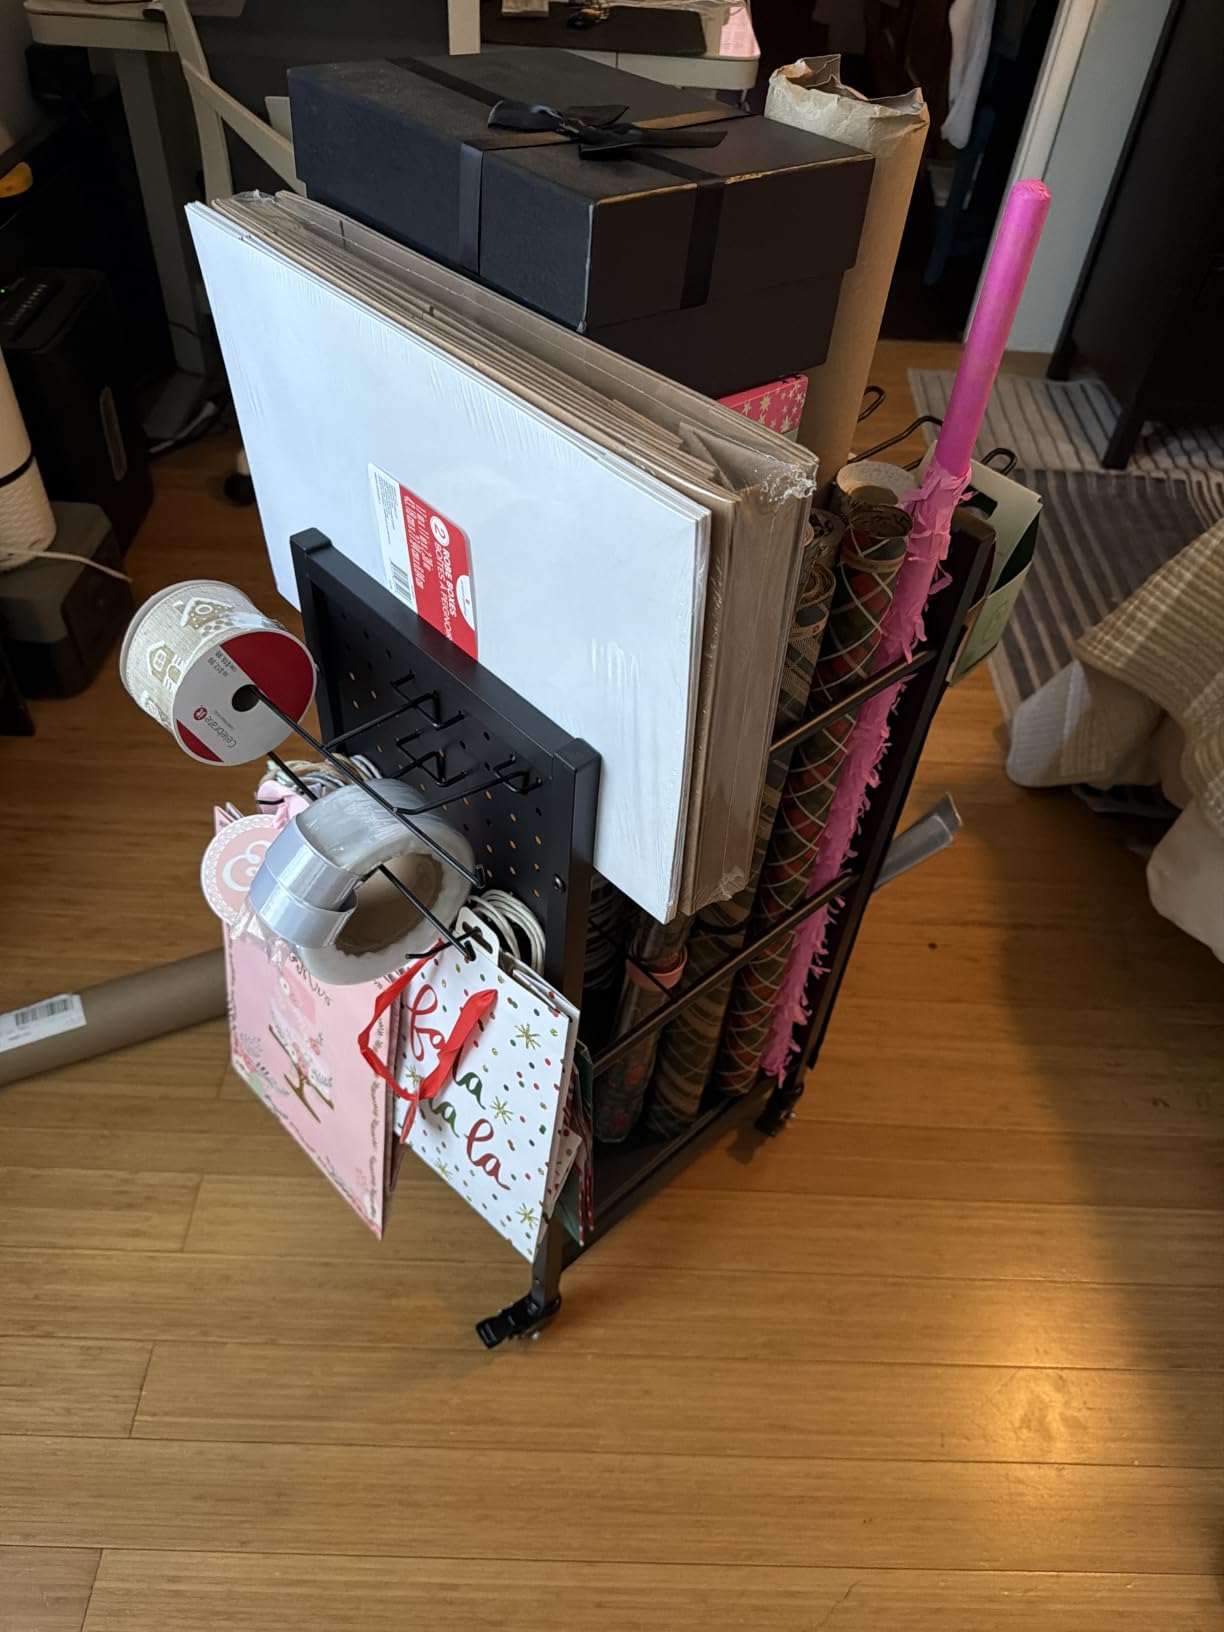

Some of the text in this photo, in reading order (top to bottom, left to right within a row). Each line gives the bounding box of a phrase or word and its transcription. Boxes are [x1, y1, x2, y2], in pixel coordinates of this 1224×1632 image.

[434, 522, 447, 542] 2
[441, 546, 456, 618] ROBE BOXES
[202, 714, 238, 749] Celebrate
[465, 1118, 511, 1191] la
